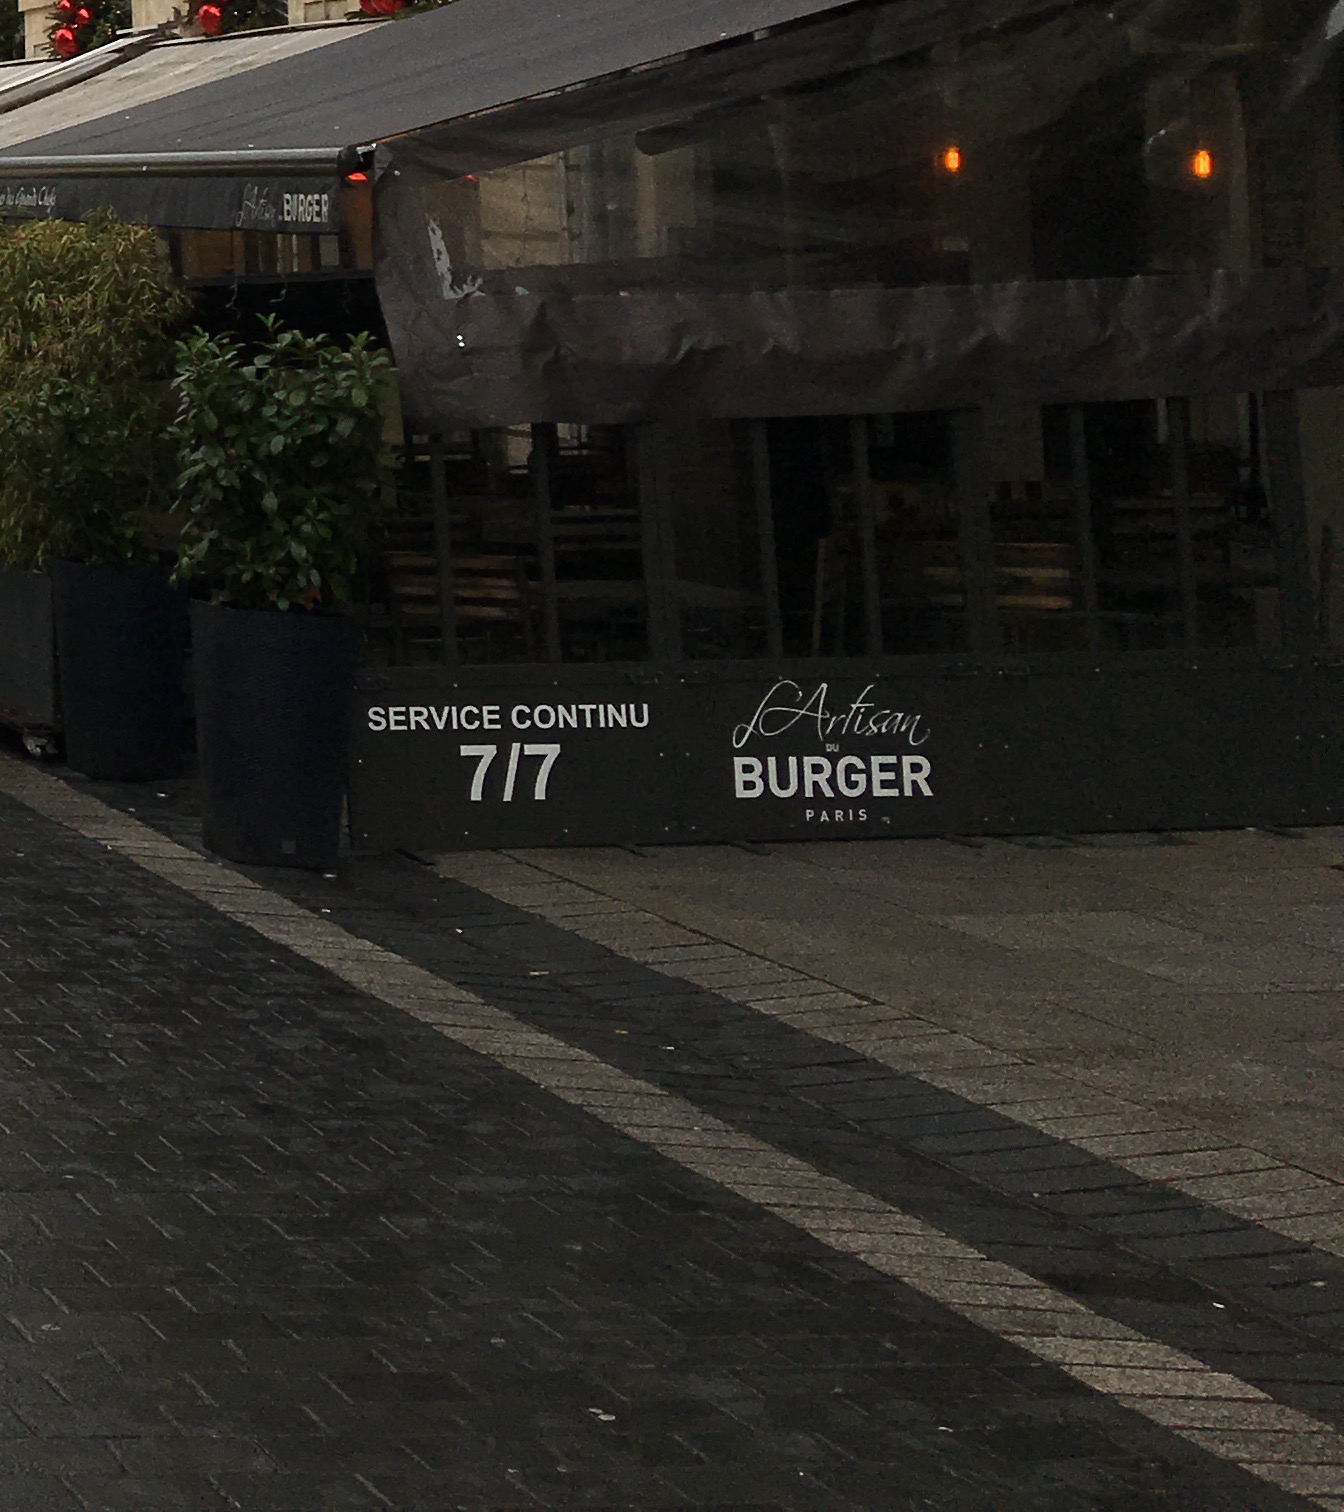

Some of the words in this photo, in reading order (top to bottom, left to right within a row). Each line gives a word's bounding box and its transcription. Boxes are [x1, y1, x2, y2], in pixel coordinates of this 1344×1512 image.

[283, 193, 329, 223] BURGER
[367, 705, 502, 731] SERVICE
[511, 703, 650, 730] CONTINU
[732, 679, 932, 749] L'Artisan
[459, 742, 561, 802] 7/7
[733, 754, 934, 798] BURGER
[805, 809, 868, 822] PARIS
